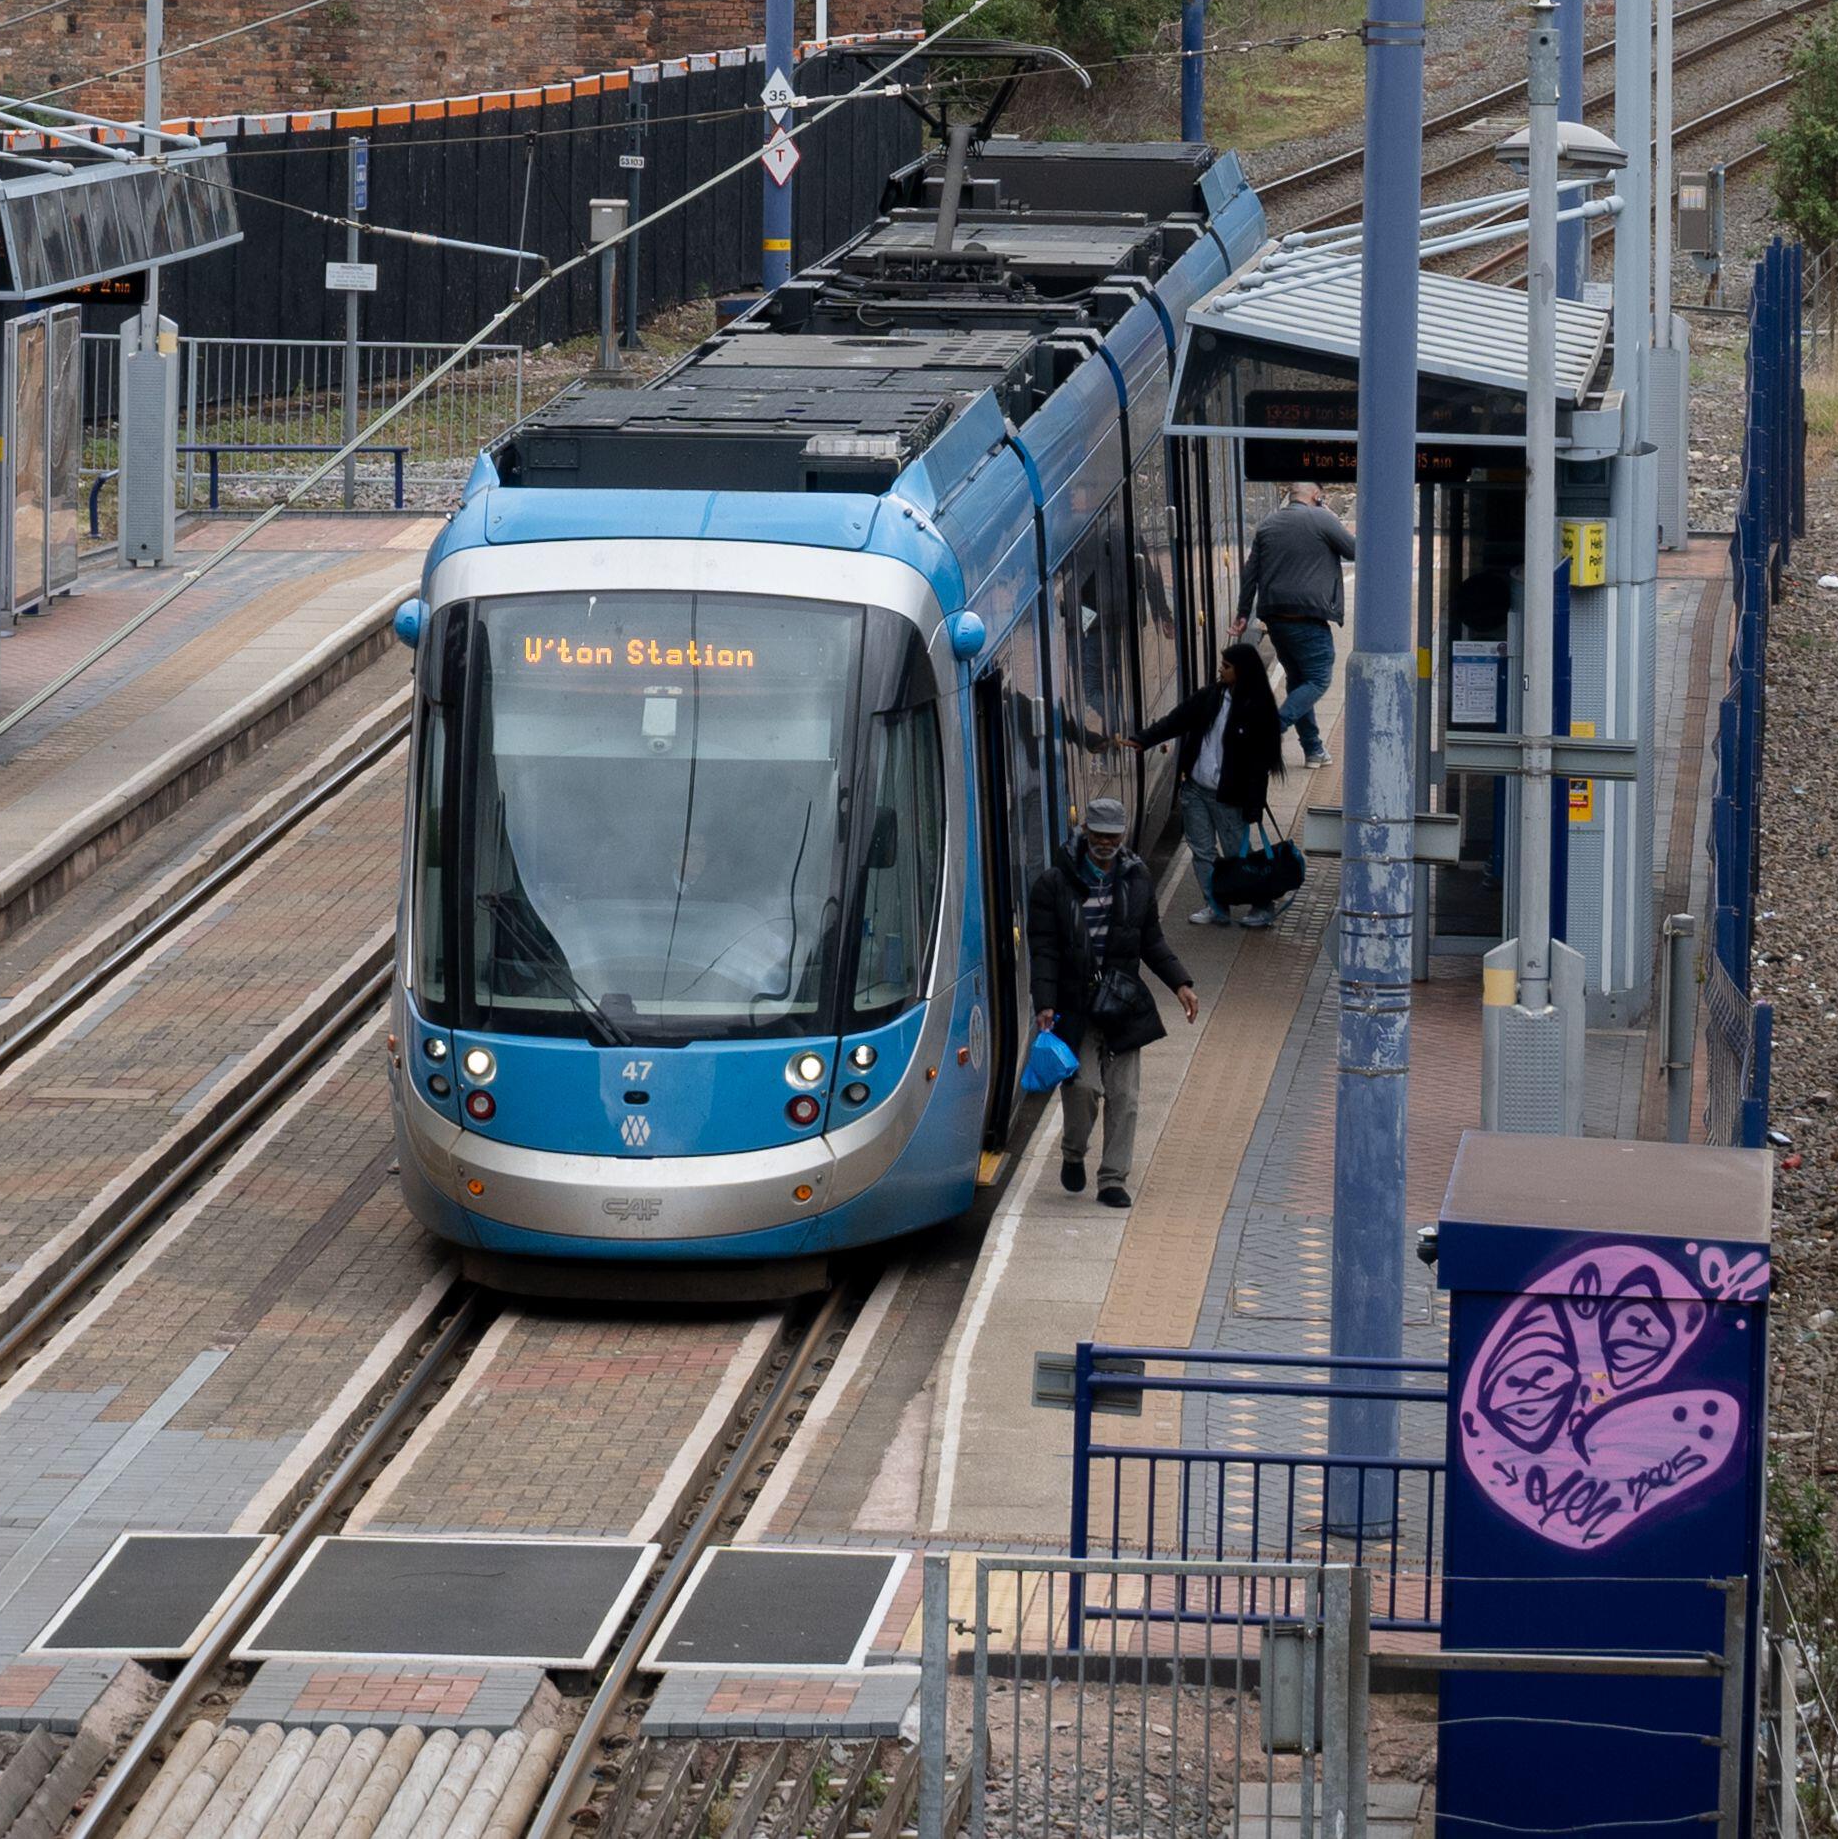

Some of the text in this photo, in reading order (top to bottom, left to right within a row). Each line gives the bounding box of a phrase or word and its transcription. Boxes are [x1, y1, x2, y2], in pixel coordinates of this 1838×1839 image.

[769, 90, 787, 101] 35
[775, 149, 785, 163] T
[114, 282, 131, 294] min
[524, 635, 754, 667] W'ton Station
[621, 1060, 654, 1081] 47
[601, 1197, 663, 1222] CAF
